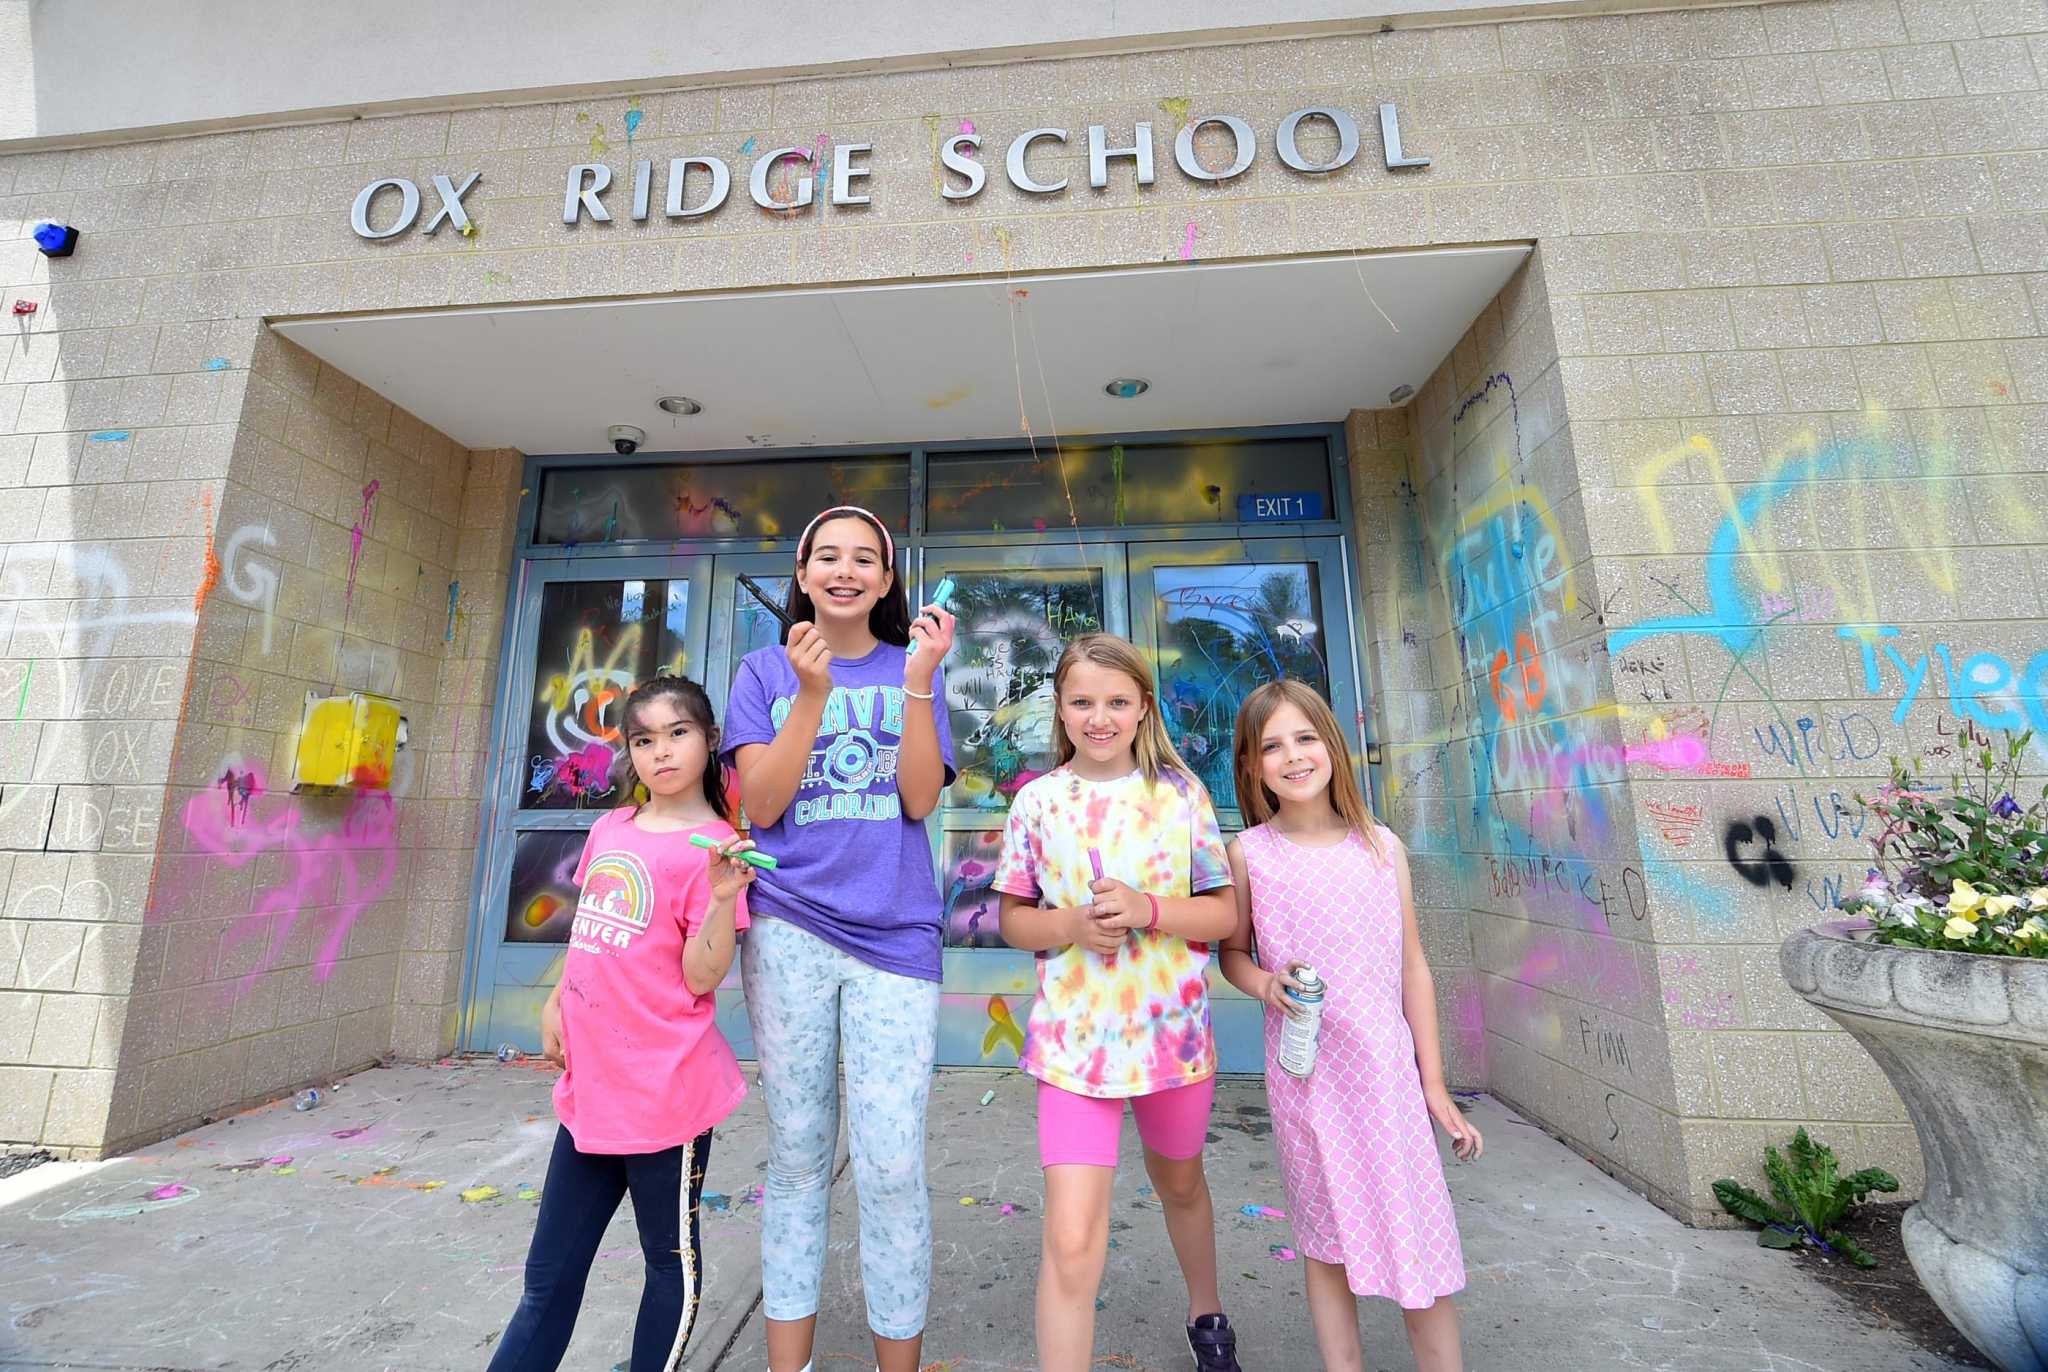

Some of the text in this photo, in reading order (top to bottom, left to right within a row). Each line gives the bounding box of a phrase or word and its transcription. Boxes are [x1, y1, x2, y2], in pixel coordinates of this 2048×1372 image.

[350, 102, 1432, 241] OX RIDGE SCHOOL
[1256, 498, 1304, 517] EXIT 1
[81, 664, 177, 714] LOVE
[92, 730, 142, 780] OX
[795, 793, 899, 826] COLORADO
[571, 916, 632, 949] ENVER
